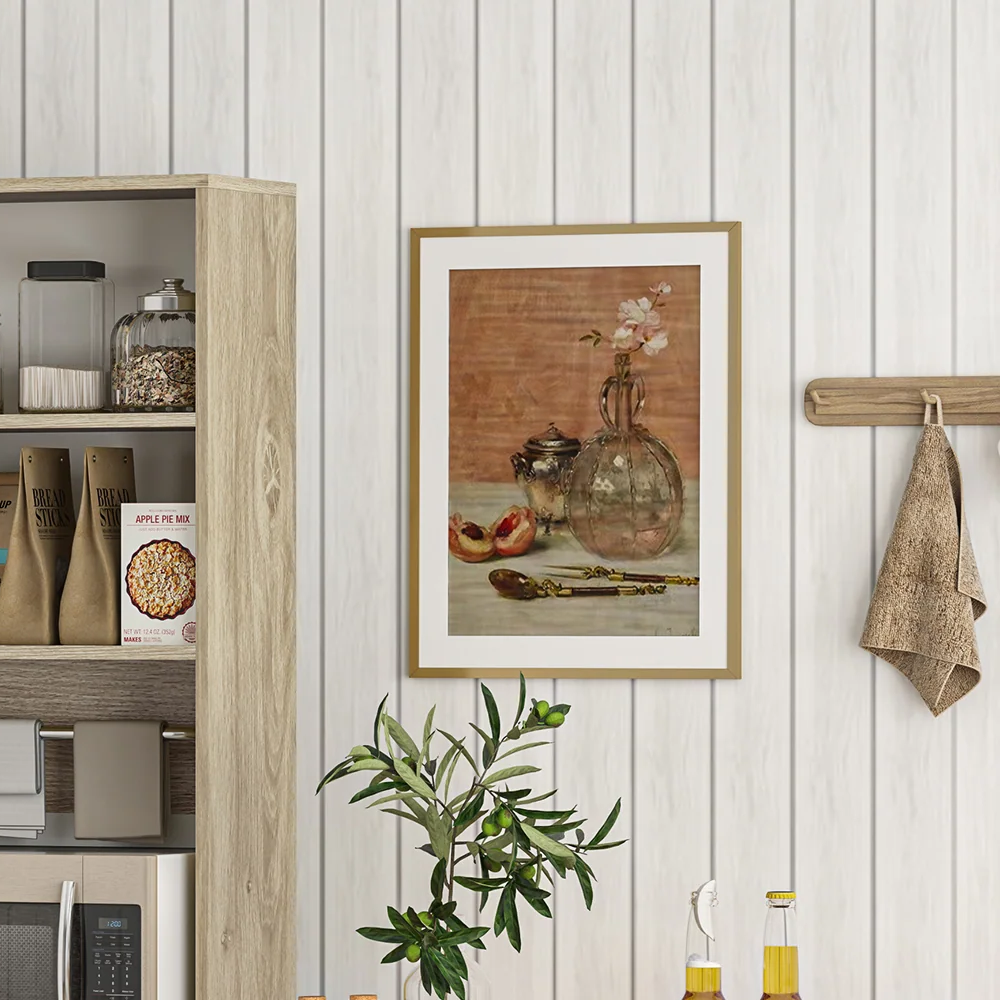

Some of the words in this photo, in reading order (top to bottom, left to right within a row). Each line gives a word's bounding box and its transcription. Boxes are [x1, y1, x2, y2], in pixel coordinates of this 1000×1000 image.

[32, 488, 67, 507] BREAD
[96, 488, 130, 507] BREAD
[35, 508, 71, 527] STICKS
[100, 508, 121, 527] STIC
[135, 514, 159, 524] APPLE
[161, 514, 174, 524] PIE
[175, 514, 191, 524] MIX
